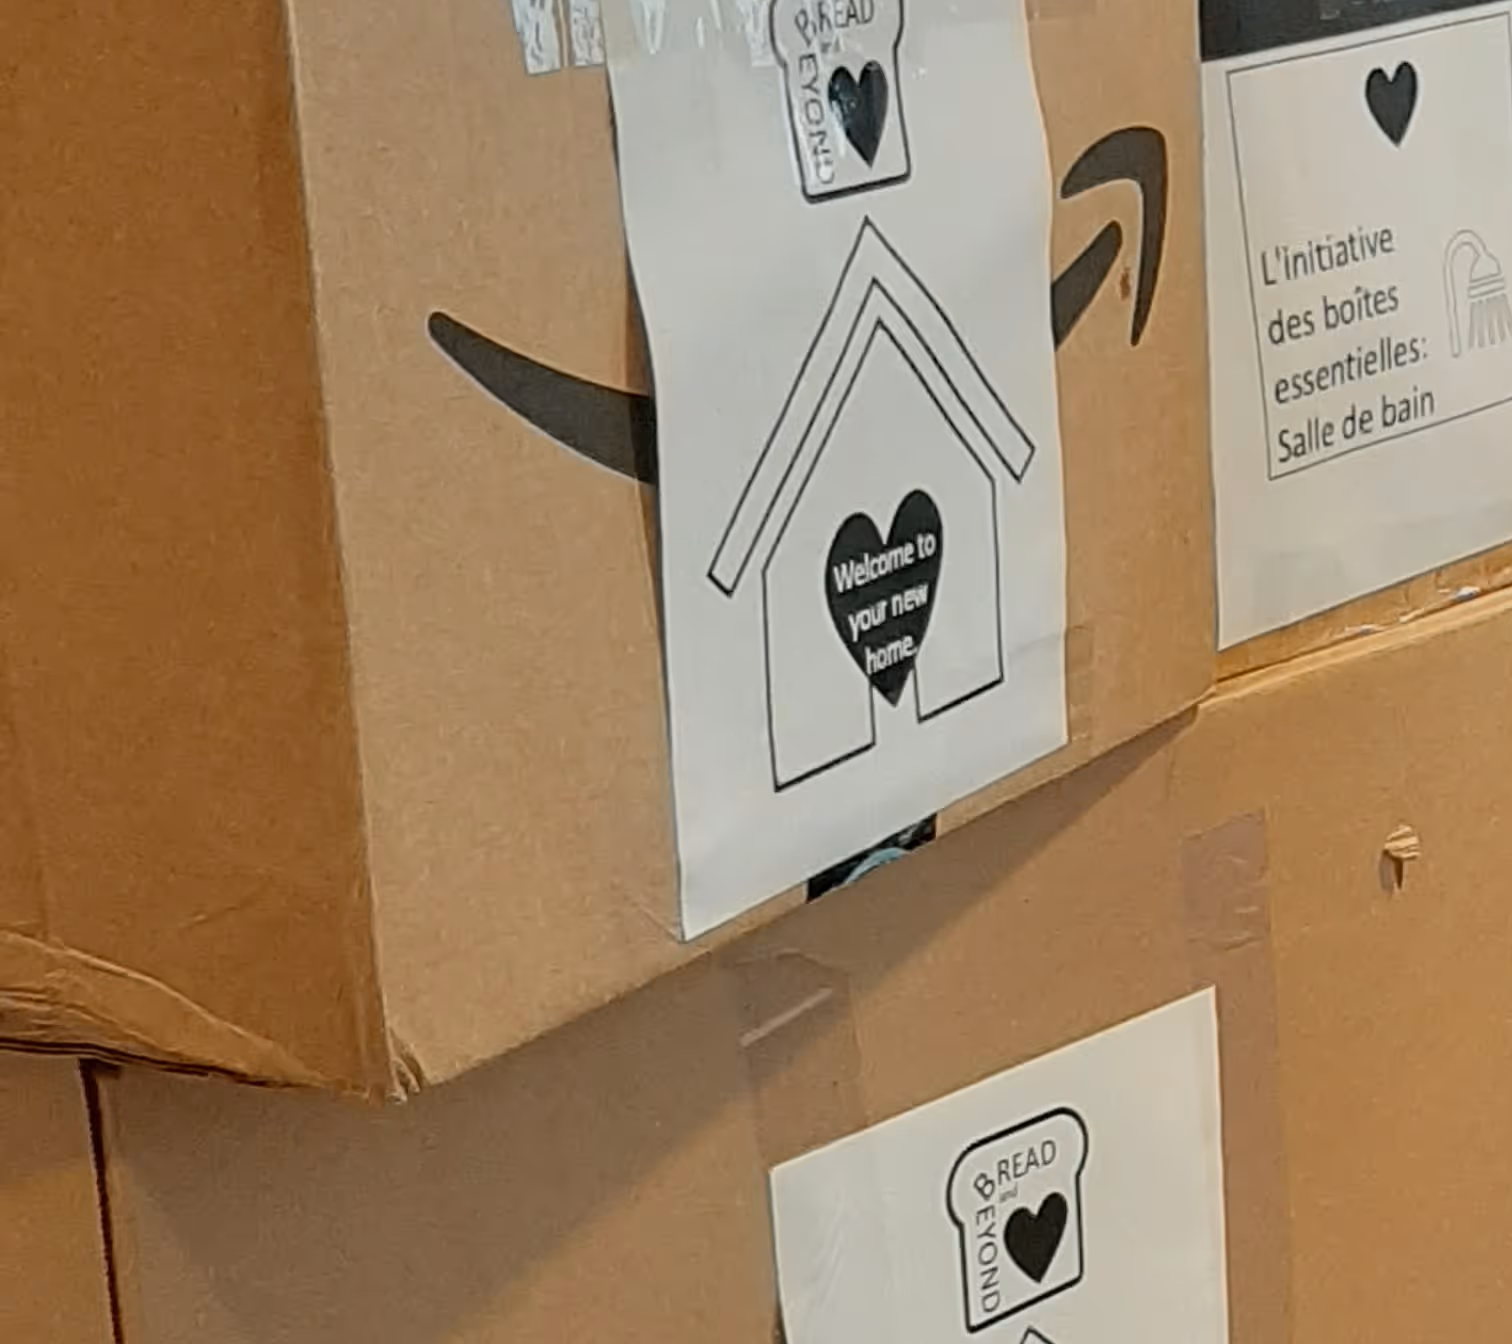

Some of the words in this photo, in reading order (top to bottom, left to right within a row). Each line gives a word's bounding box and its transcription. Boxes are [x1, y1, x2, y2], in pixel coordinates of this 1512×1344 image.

[1260, 226, 1395, 286] L'initiative
[1267, 309, 1315, 345] des
[1322, 285, 1400, 331] boîtes
[1274, 336, 1429, 405] essentielles:
[1277, 418, 1335, 464] Salle
[1341, 403, 1374, 440] de
[1381, 386, 1436, 428] bain
[833, 541, 914, 594] Welcome
[916, 532, 937, 560] to
[848, 600, 888, 643] your
[891, 584, 929, 617] new
[973, 1139, 1057, 1203] BREAD
